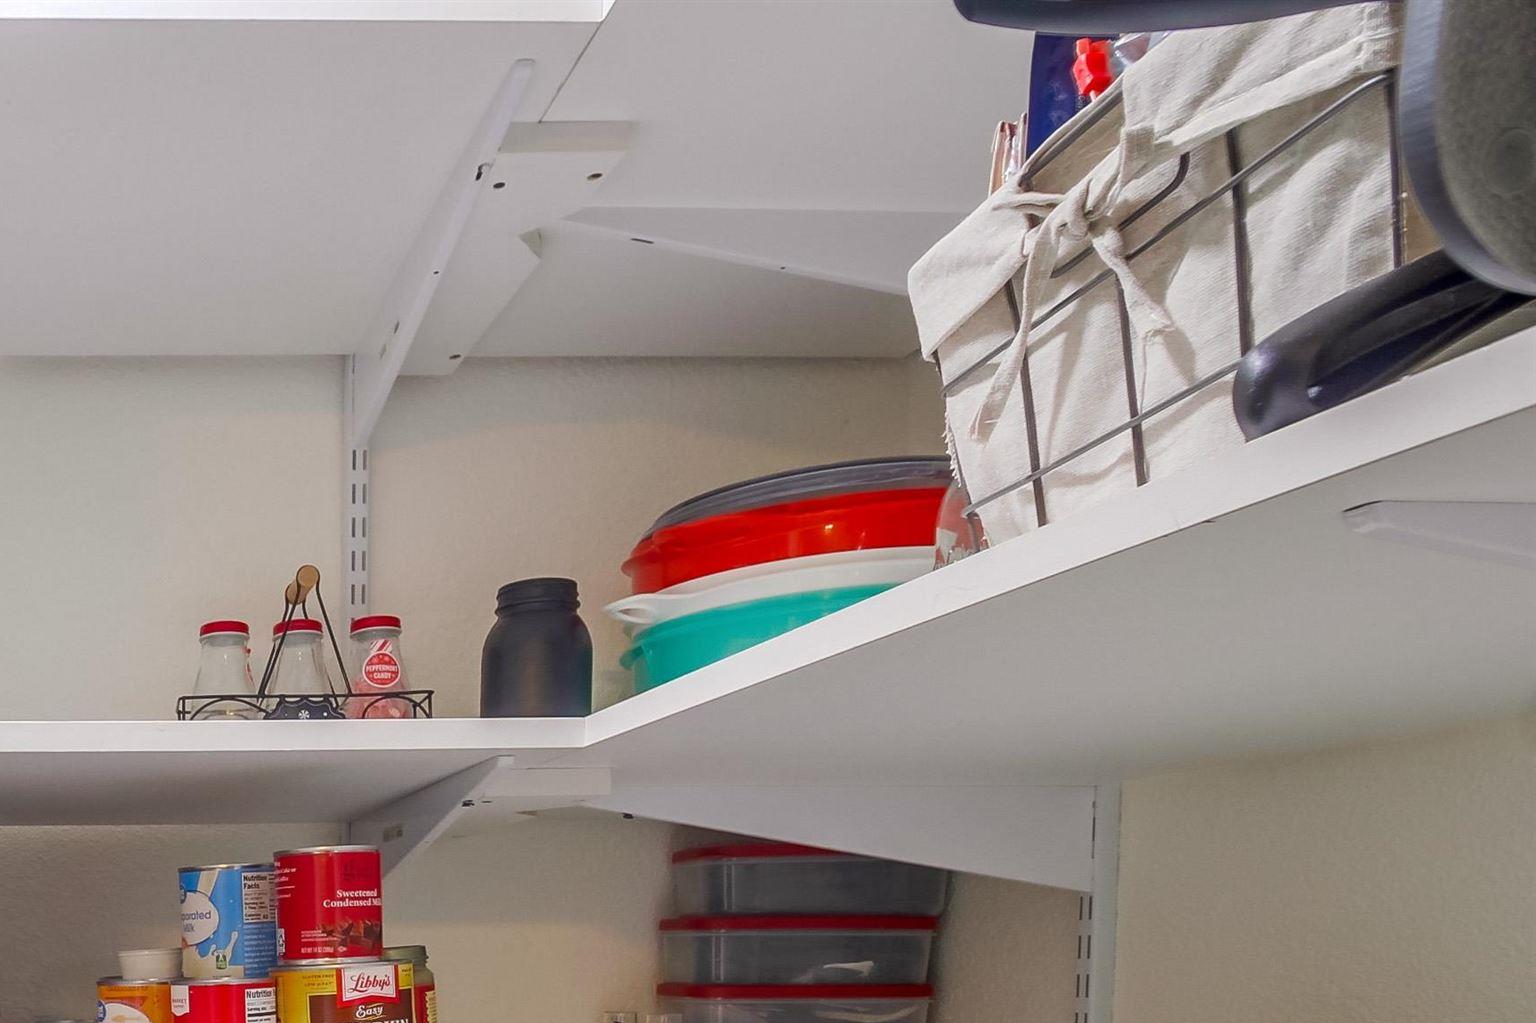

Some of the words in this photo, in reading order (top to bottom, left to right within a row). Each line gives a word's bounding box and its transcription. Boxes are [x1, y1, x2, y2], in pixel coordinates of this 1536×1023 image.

[336, 889, 378, 898] Sweetened
[323, 899, 372, 908] Condensed
[347, 972, 391, 993] Libby's
[355, 1005, 384, 1018] Easy
